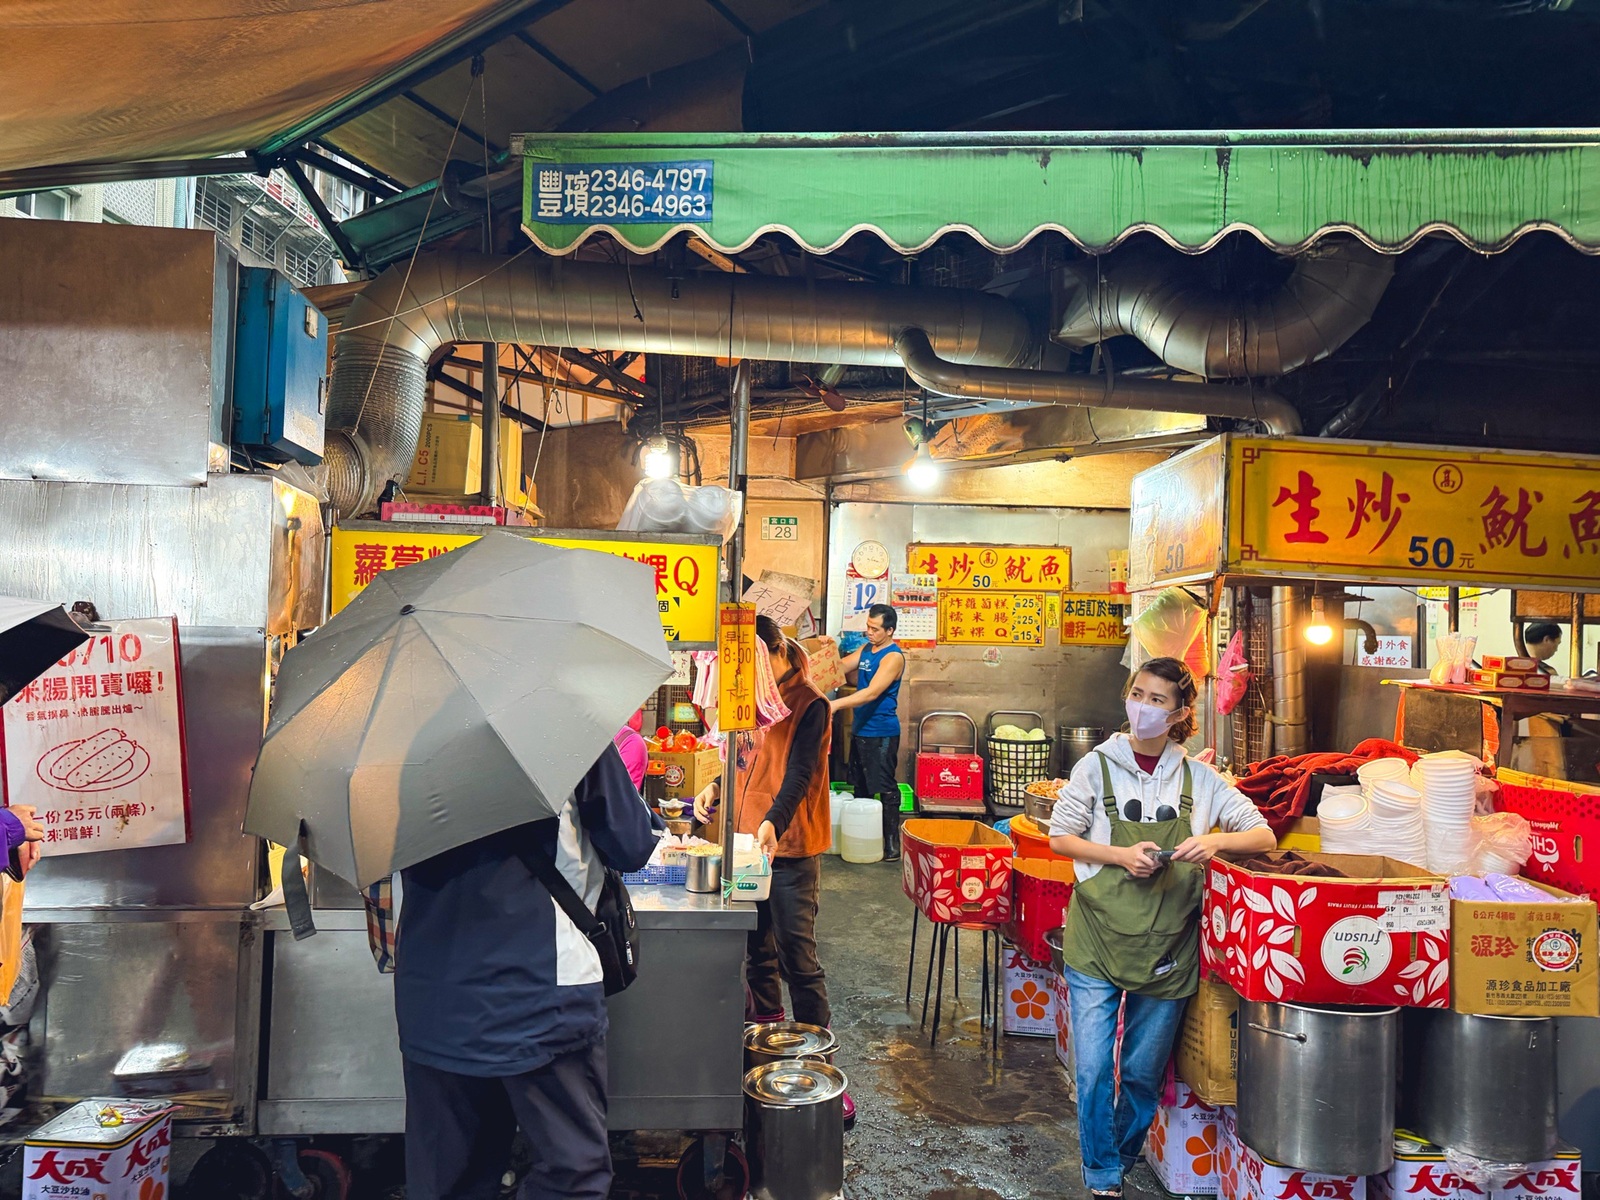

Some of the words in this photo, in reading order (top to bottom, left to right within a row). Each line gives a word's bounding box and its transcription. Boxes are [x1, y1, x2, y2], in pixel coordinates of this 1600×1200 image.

[590, 168, 707, 192] 2346-4797
[590, 194, 706, 217] 2346-4963
[418, 450, 429, 466] C5
[775, 526, 792, 538] 28
[1164, 542, 1184, 573] 50
[854, 582, 877, 611] 12
[949, 611, 1008, 623] 糯米腸
[1064, 599, 1124, 617] 本店訂於每
[726, 631, 750, 644] 早上
[39, 825, 101, 843] 來嚐鮮!
[1333, 930, 1382, 945] frusan
[1471, 935, 1519, 958] 源珍
[1486, 980, 1571, 992] 源珍食品加工廠
[27, 1150, 112, 1184] 大成
[41, 1185, 91, 1196] 大豆沙拉油
